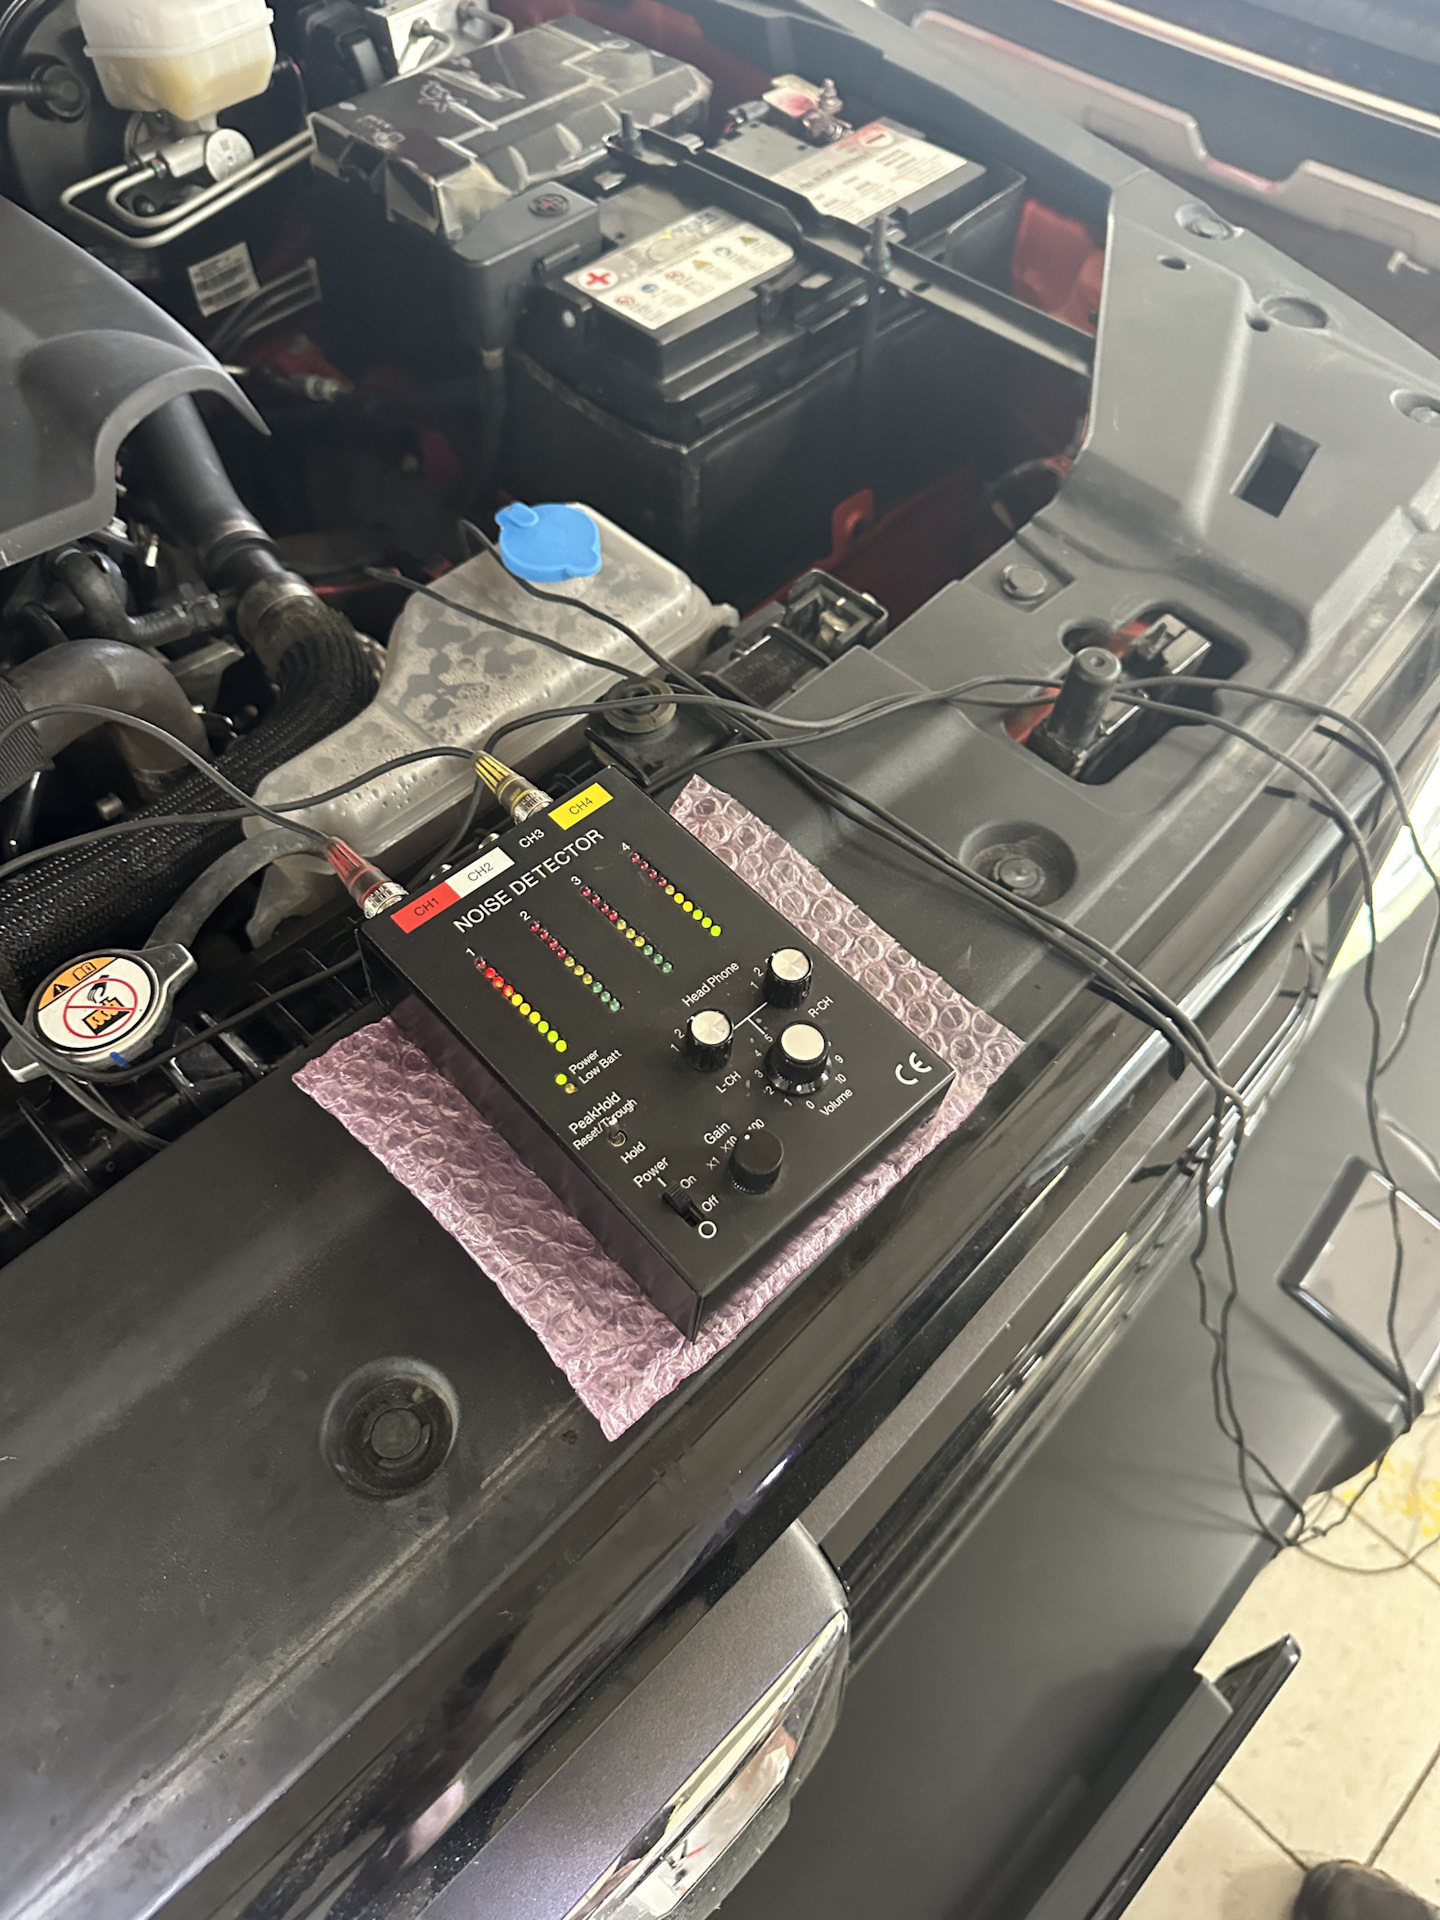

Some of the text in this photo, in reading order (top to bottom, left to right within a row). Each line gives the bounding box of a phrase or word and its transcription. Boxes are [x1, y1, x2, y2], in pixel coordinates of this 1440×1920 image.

[569, 797, 593, 815] CH4
[519, 829, 544, 848] CH3
[622, 842, 630, 851] 4
[467, 862, 494, 881] CH2
[452, 829, 604, 934] NOISE DETECTOR
[571, 876, 581, 885] 3
[414, 897, 439, 916] CH1
[520, 911, 531, 921] 2
[466, 948, 475, 956] 1
[753, 966, 764, 977] 2
[681, 962, 740, 1007] Head Phone
[750, 981, 759, 989] 1
[808, 996, 833, 1018] R-CH
[674, 1028, 685, 1039] 2
[764, 1034, 773, 1042] 5
[670, 1043, 679, 1052] 1
[754, 1049, 763, 1057] 4
[568, 1050, 599, 1075] Power
[834, 1055, 843, 1063] 9
[578, 1050, 623, 1084] Low Batt
[754, 1069, 763, 1078] 3
[895, 1052, 932, 1085] CE
[716, 1071, 741, 1093] L-CH
[835, 1073, 846, 1084] 10
[765, 1085, 775, 1096] 2
[784, 1098, 792, 1106] 1
[806, 1100, 815, 1109] 0
[819, 1089, 853, 1116] Volume
[704, 1123, 731, 1144] Gain
[620, 1141, 646, 1164] Hold
[633, 1157, 668, 1188] Power
[680, 1175, 697, 1189] On
[701, 1195, 719, 1212] Off
